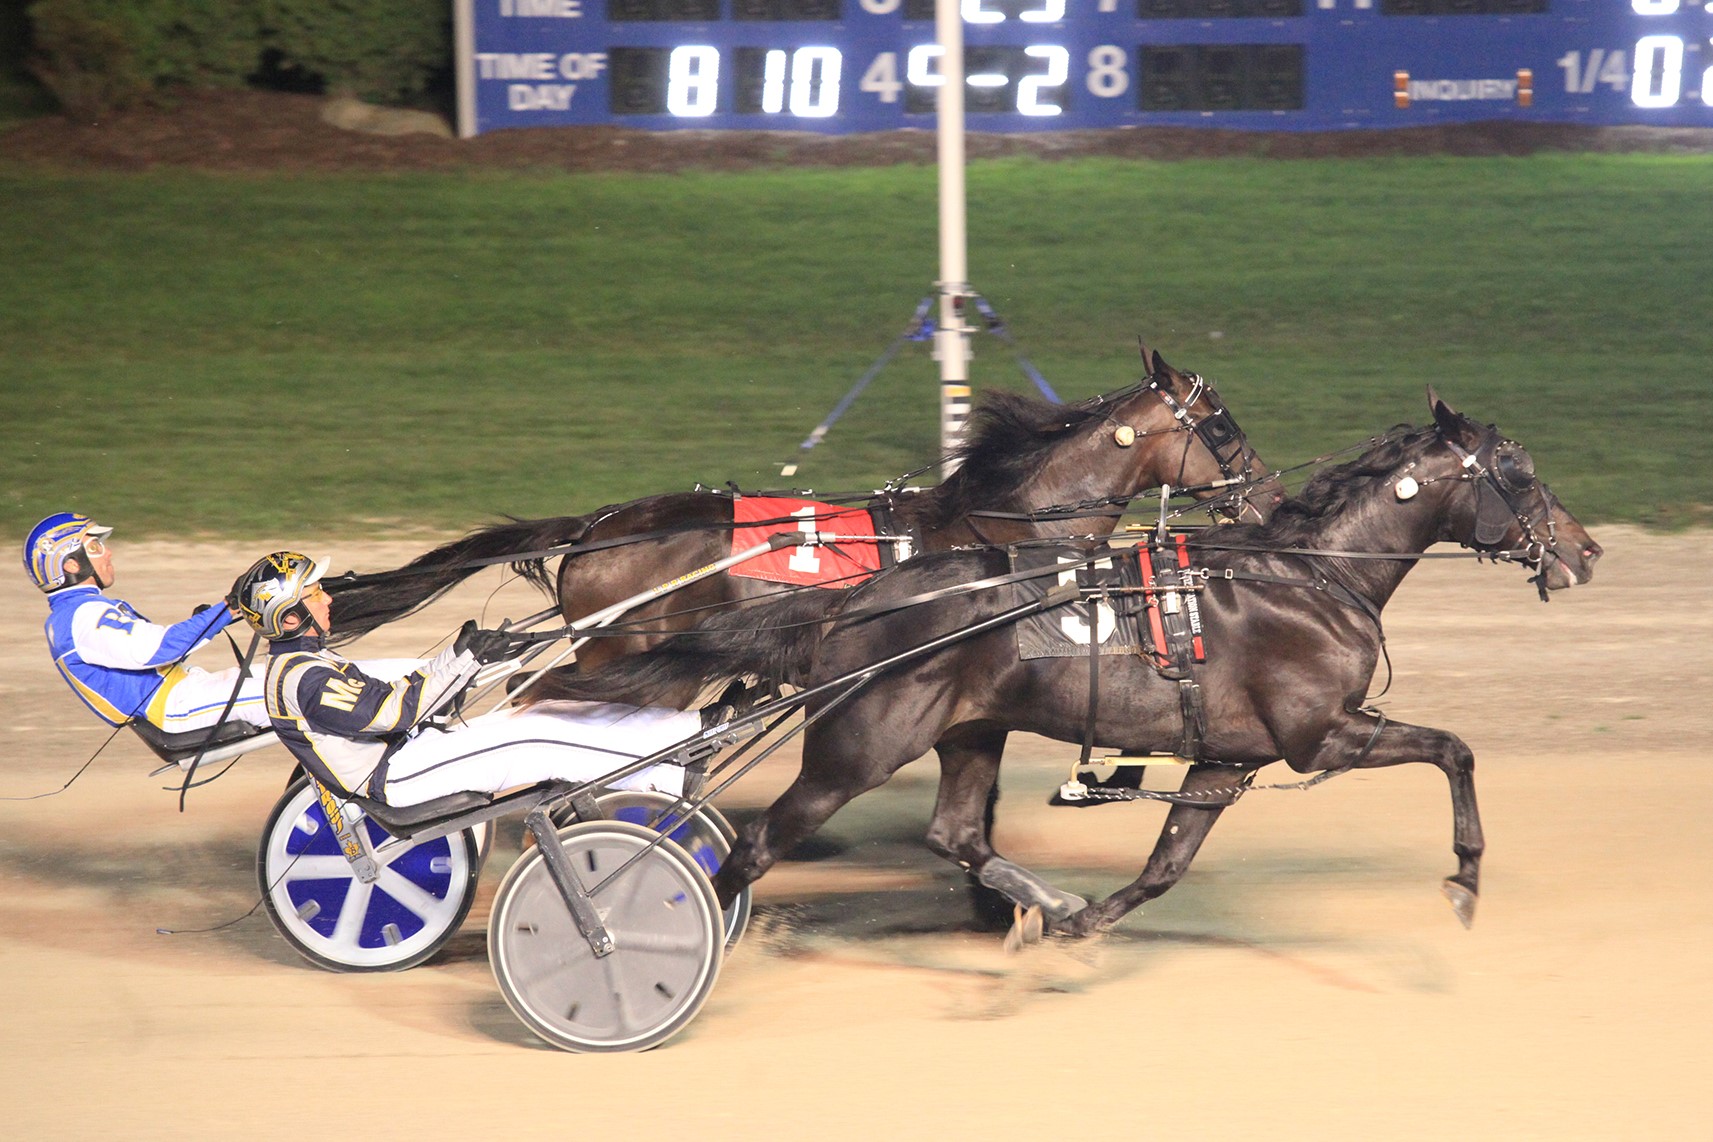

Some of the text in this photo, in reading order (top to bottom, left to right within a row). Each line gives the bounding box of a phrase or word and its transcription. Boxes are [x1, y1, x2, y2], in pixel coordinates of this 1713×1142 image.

[476, 52, 608, 79] TIME OF
[667, 45, 721, 117] 8
[762, 46, 843, 117] 10
[859, 51, 903, 103] 4
[1086, 44, 1130, 98] 8
[1556, 49, 1630, 94] 1/4
[508, 84, 577, 111] DAY
[788, 506, 821, 574] 1
[319, 676, 367, 713] Mc
